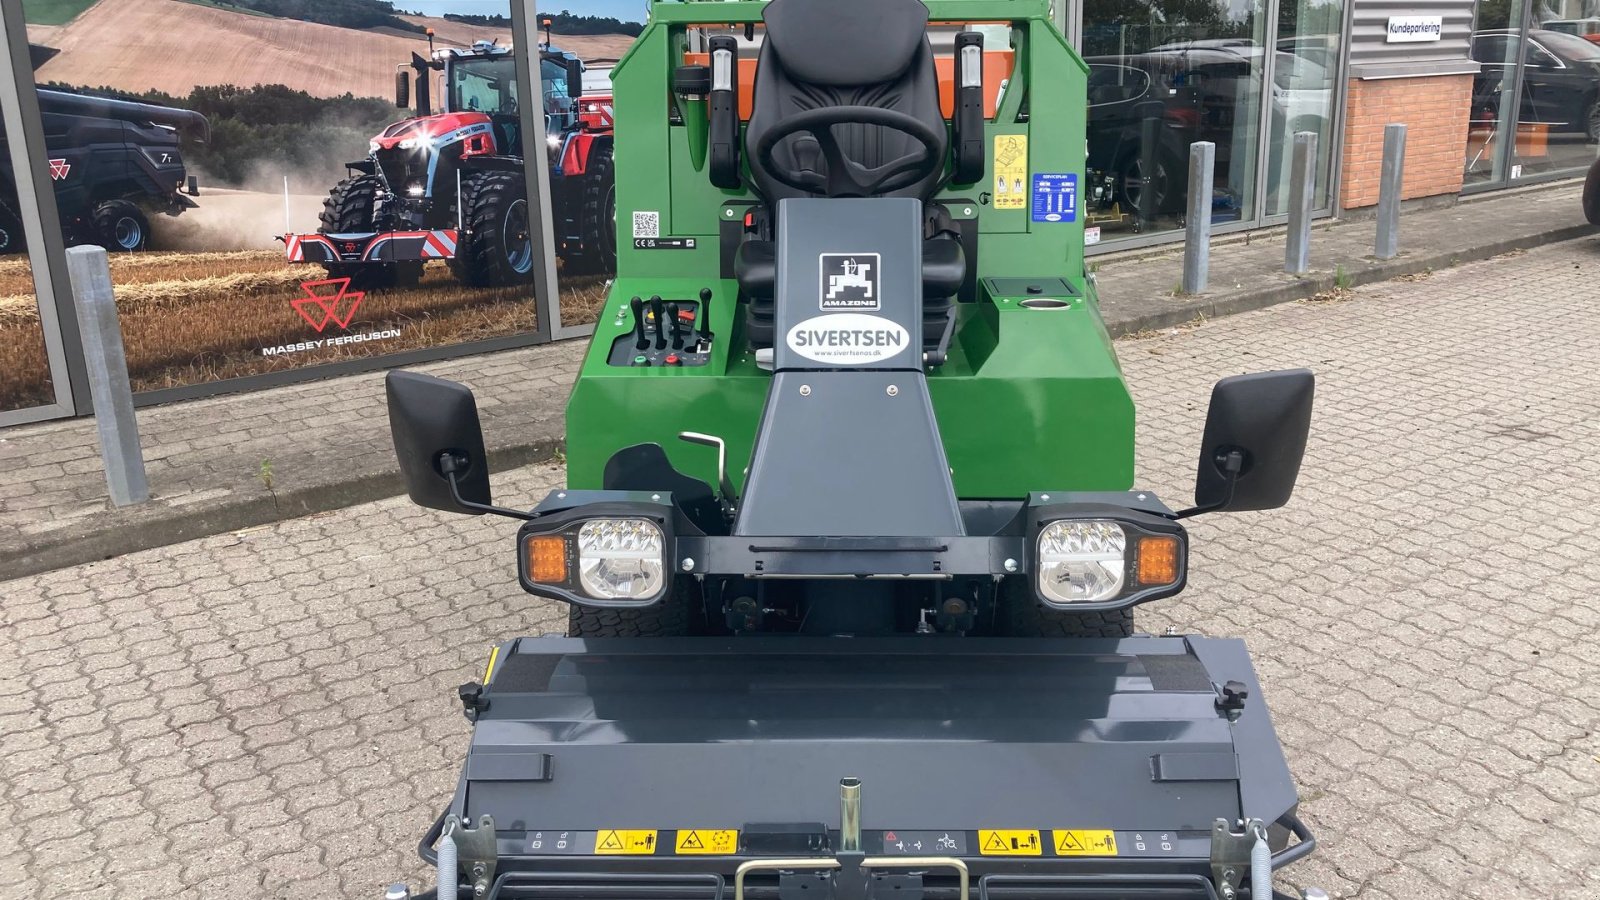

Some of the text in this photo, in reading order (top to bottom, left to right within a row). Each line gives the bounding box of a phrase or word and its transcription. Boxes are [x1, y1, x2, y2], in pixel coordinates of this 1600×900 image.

[1389, 21, 1440, 35] Kundeparkering
[262, 328, 401, 356] MASSEY FERGUSON
[795, 329, 901, 347] SIVERTSEN
